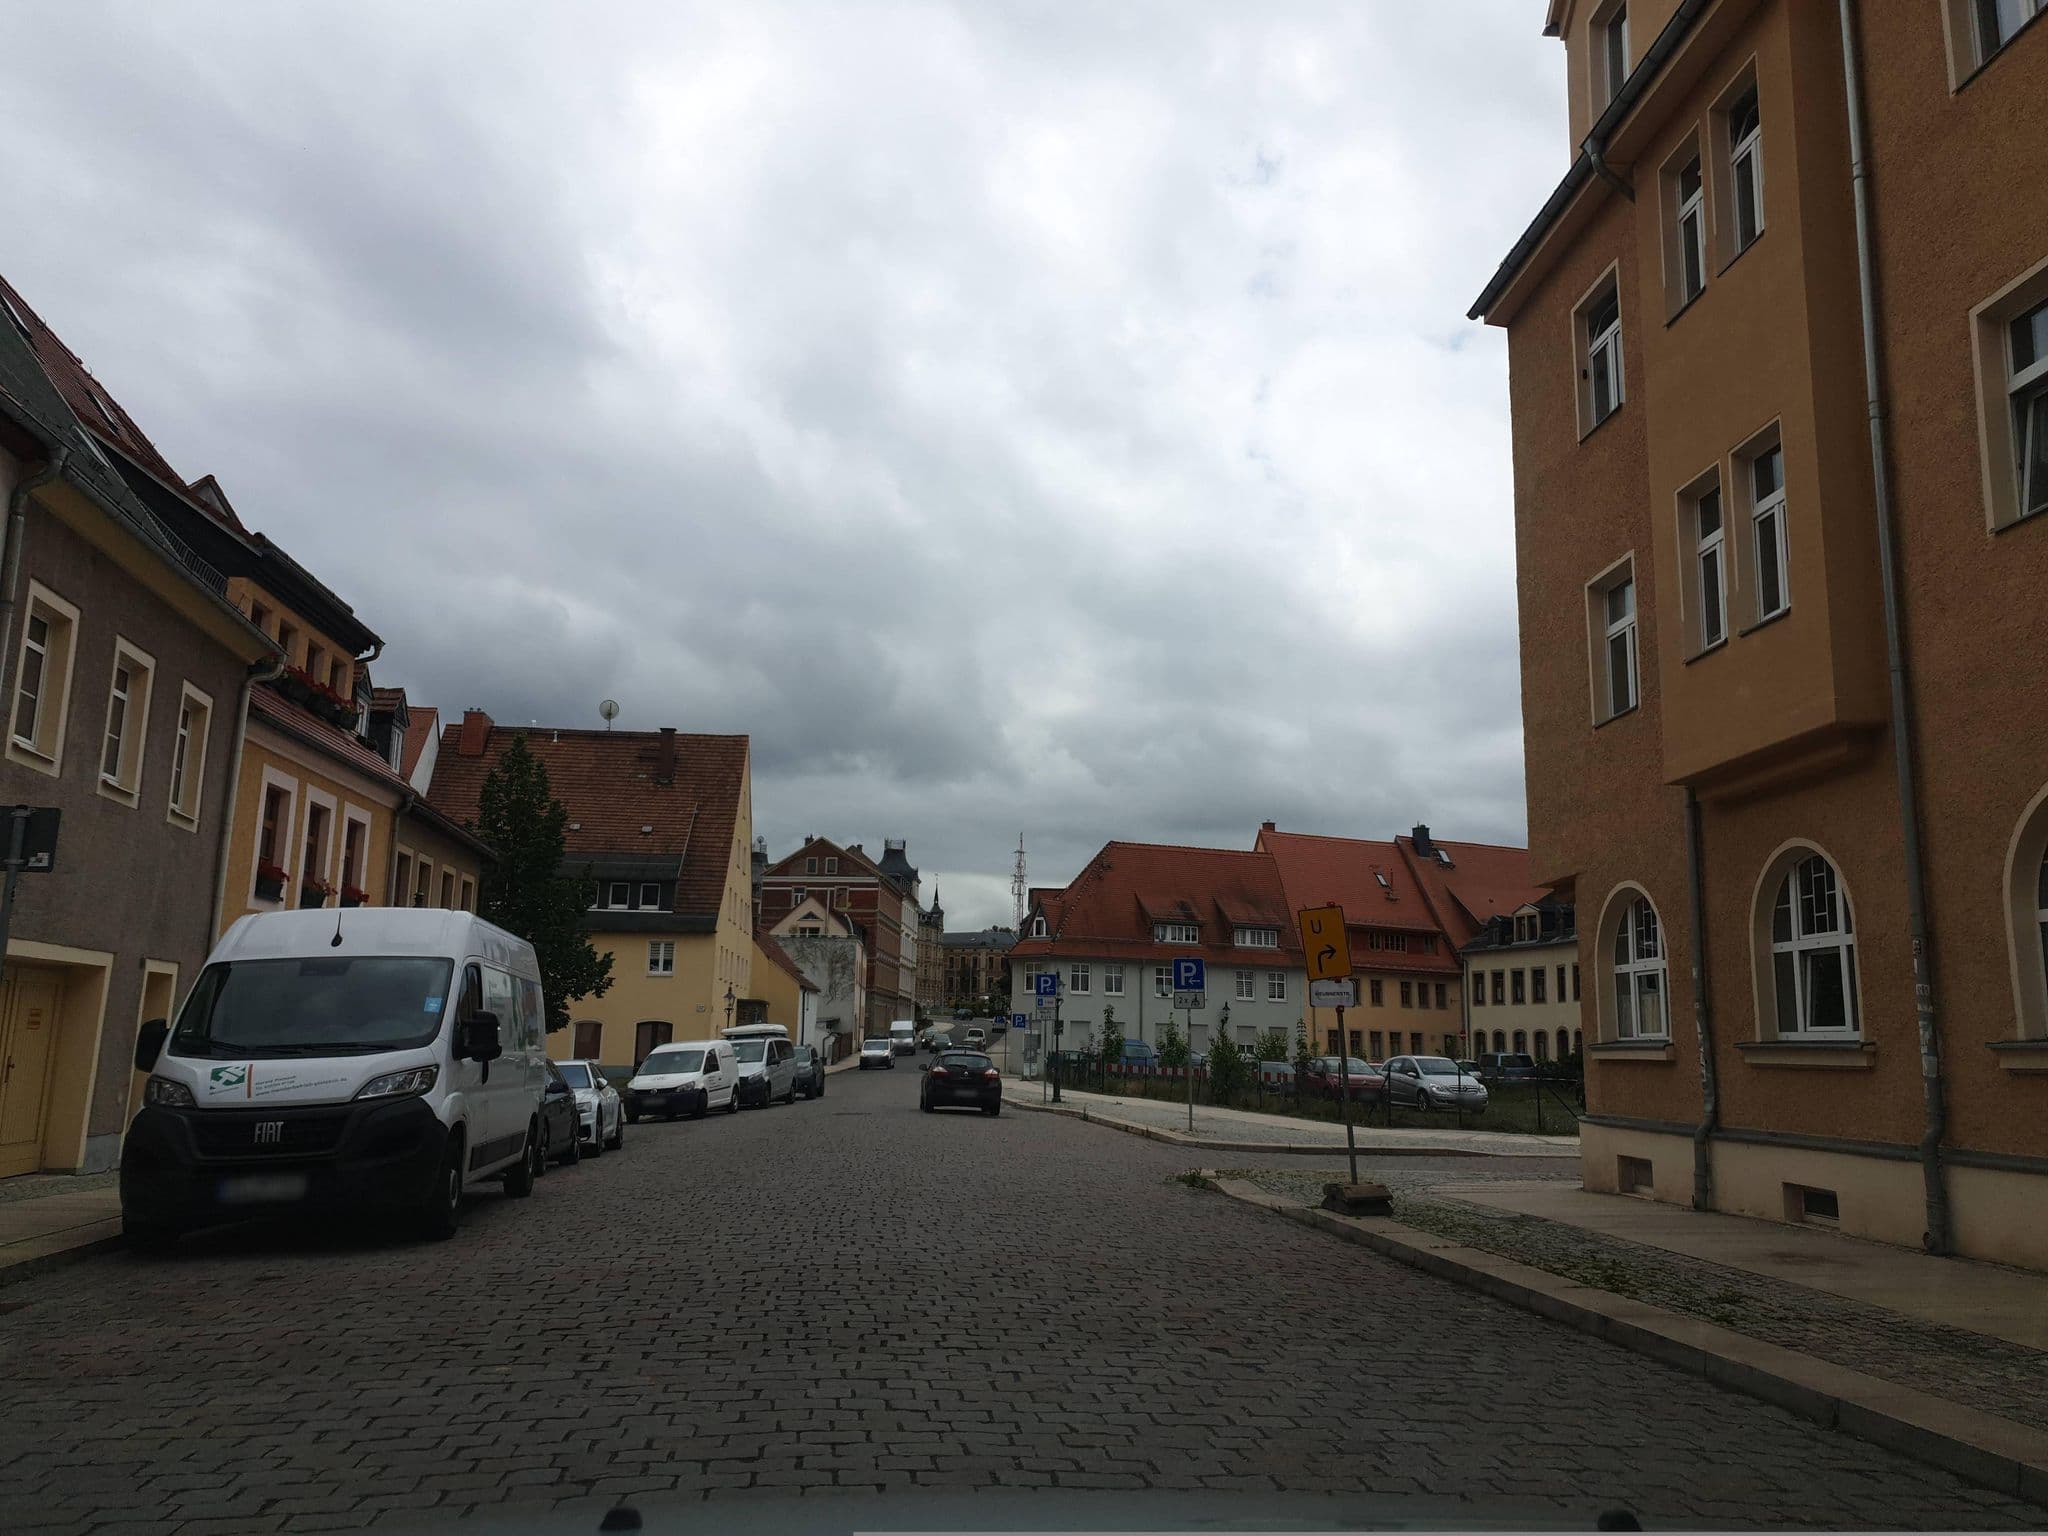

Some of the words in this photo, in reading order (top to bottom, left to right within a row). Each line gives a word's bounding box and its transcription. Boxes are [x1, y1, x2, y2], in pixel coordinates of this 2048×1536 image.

[1310, 919, 1322, 934] U
[1180, 961, 1197, 986] P
[1040, 976, 1052, 993] P
[1015, 1015, 1023, 1026] P
[254, 1121, 284, 1143] FIAT
